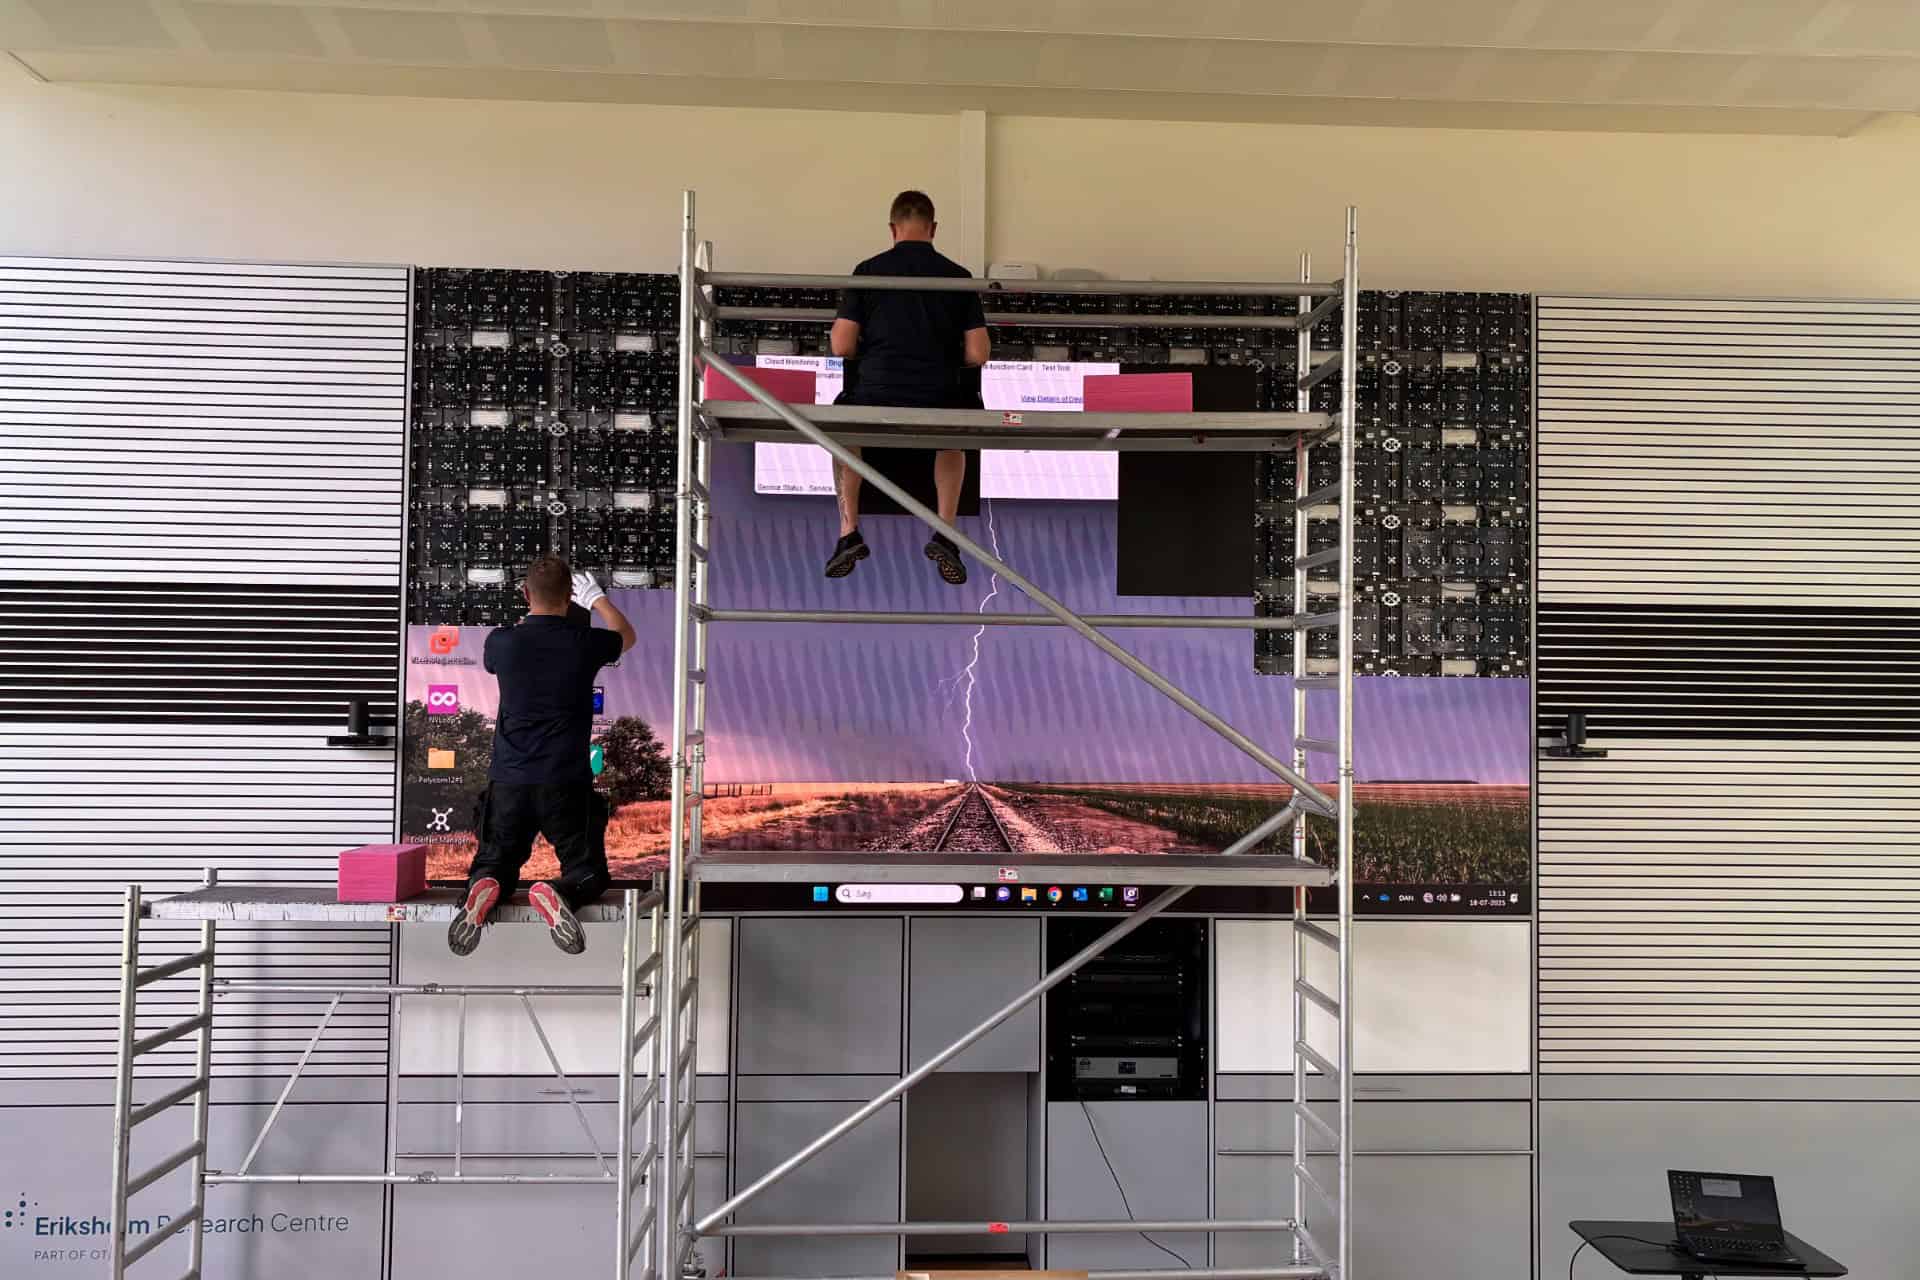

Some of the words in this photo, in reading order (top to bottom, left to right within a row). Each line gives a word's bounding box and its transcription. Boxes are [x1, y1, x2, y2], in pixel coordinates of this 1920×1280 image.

[35, 1216, 149, 1236] Erikshm
[271, 1213, 349, 1233] Centre
[34, 1250, 64, 1261] PART
[68, 1250, 86, 1260] OF
